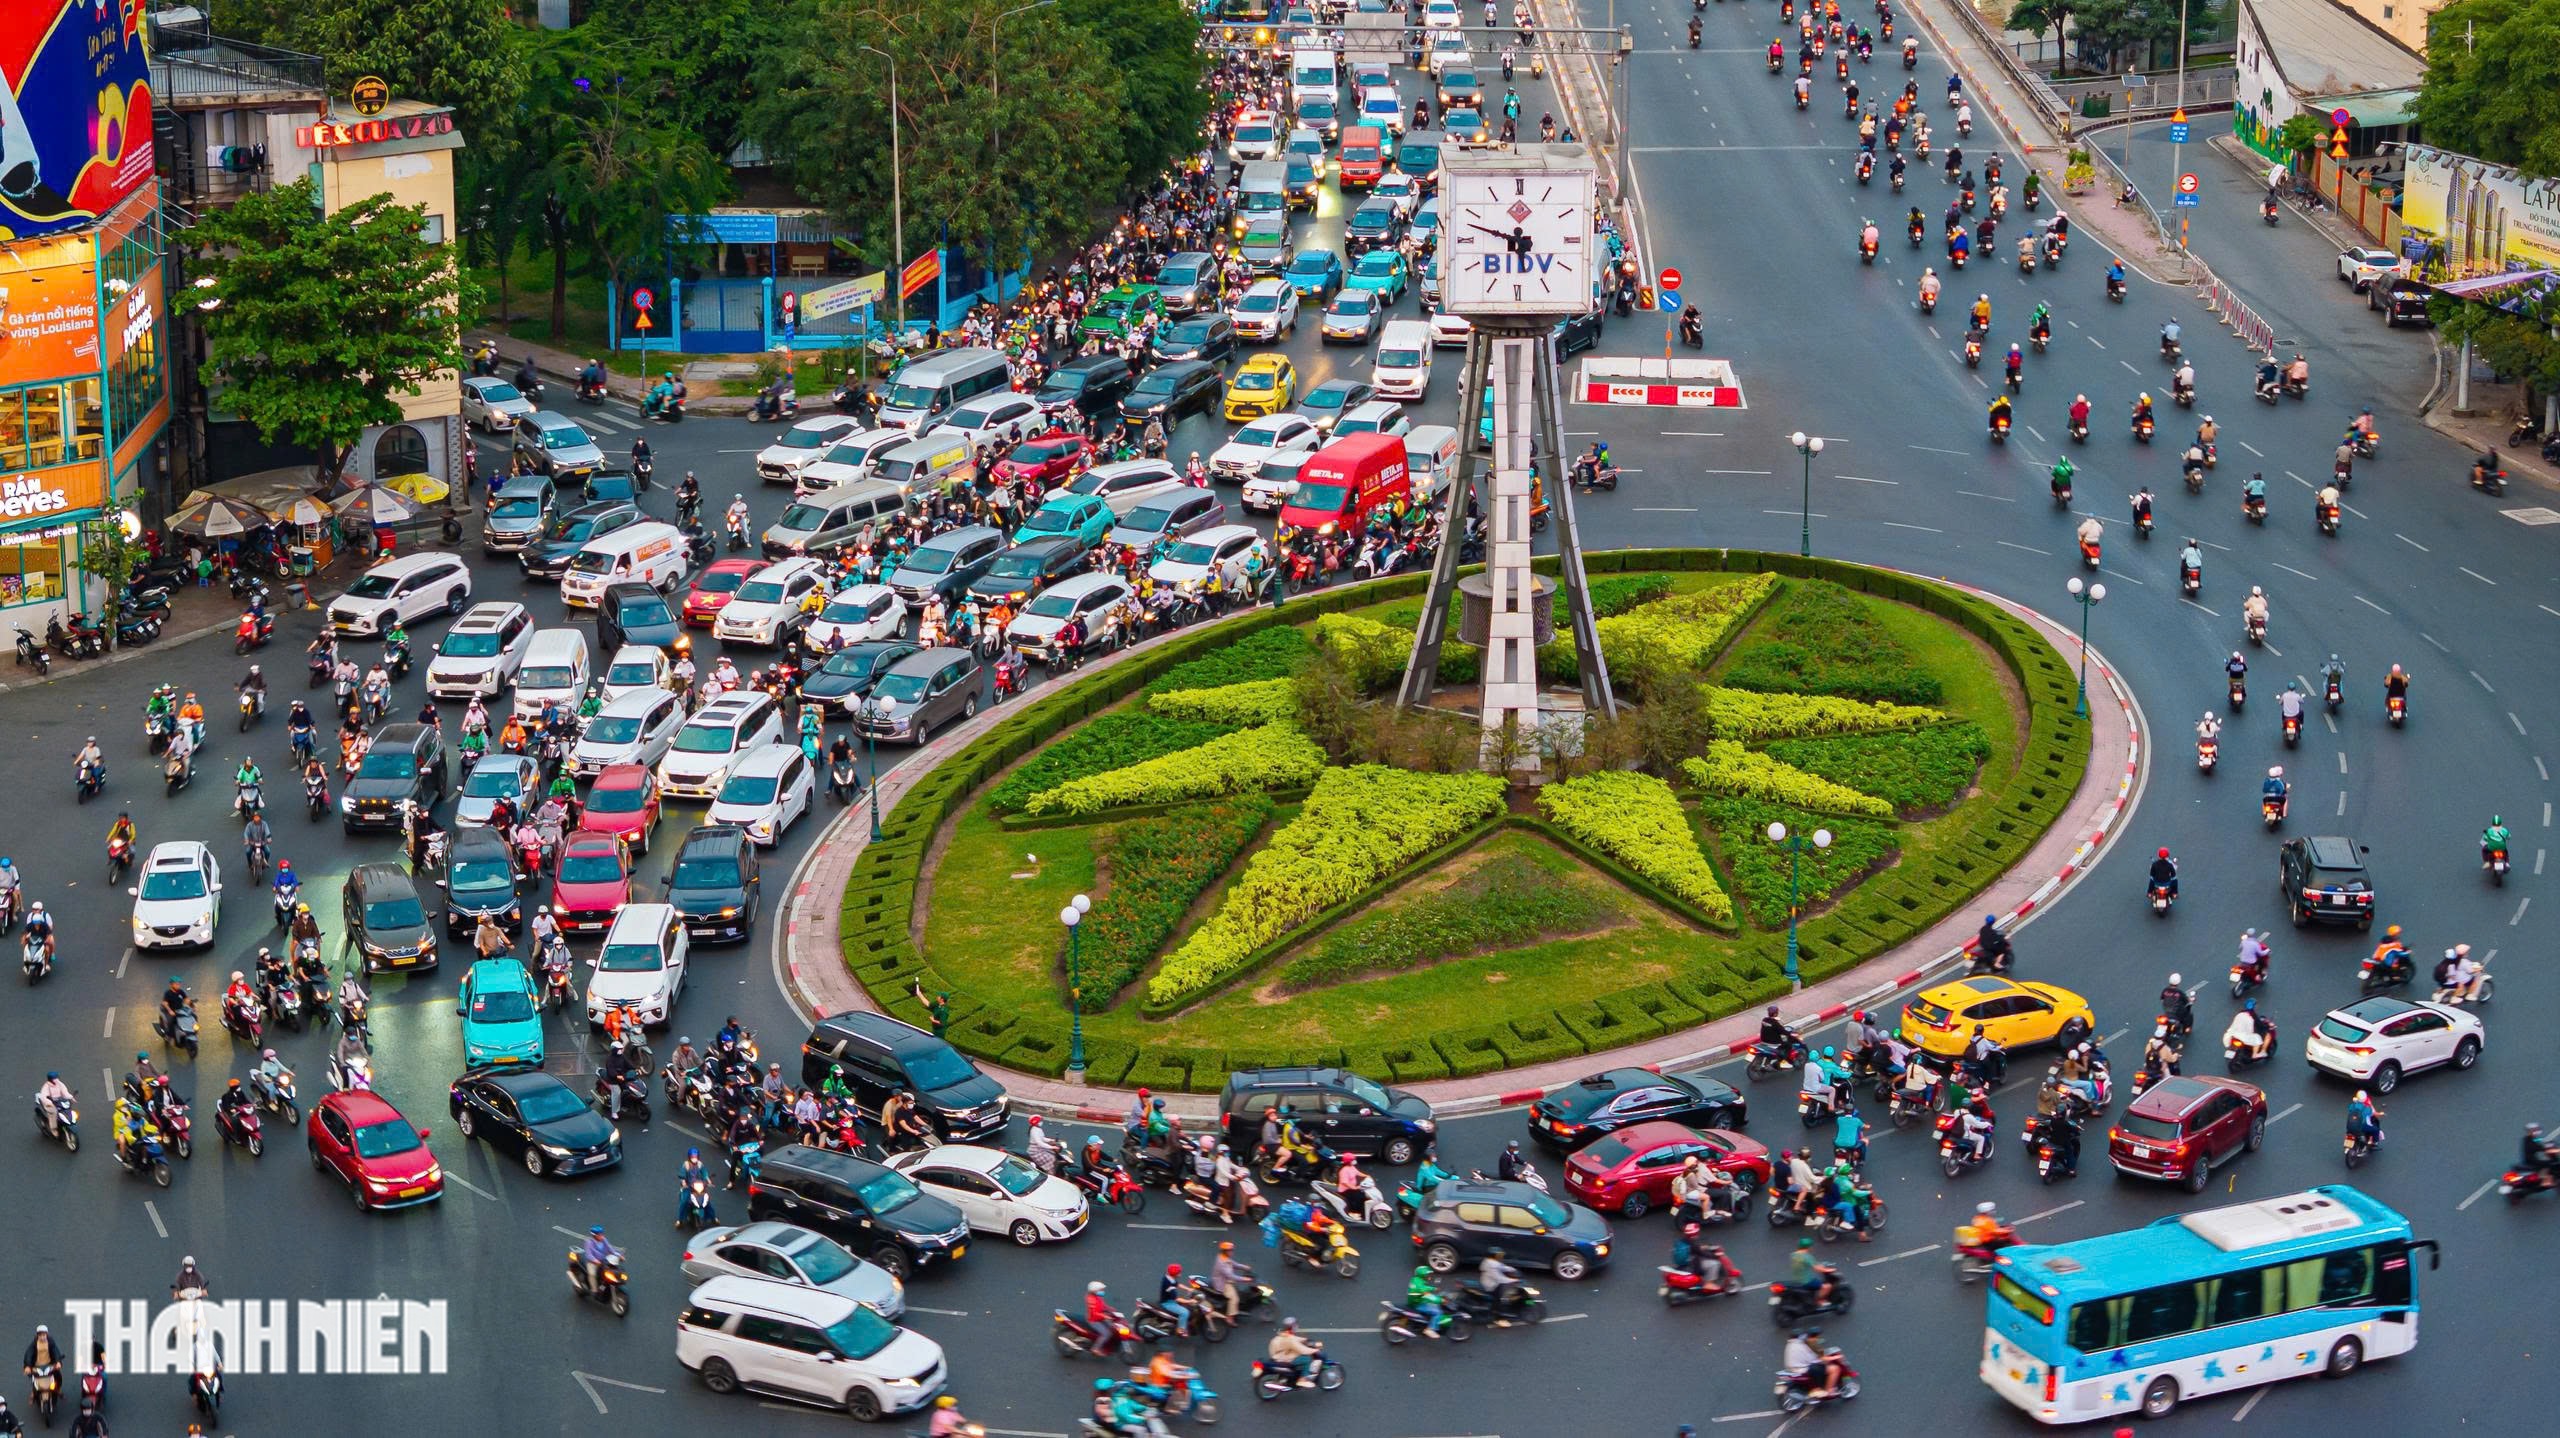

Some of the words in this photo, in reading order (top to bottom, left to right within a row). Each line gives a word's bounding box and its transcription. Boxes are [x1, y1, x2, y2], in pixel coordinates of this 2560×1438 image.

[354, 119, 403, 144] CUA
[407, 113, 454, 139] 245
[2523, 183, 2543, 209] LA
[1484, 253, 1554, 274] BIDV
[9, 312, 24, 325] Gà
[26, 310, 45, 323] rán
[66, 303, 94, 318] tiếng
[10, 326, 39, 339] vùng
[41, 318, 95, 335] Louisiana
[3, 474, 41, 498] RÁN
